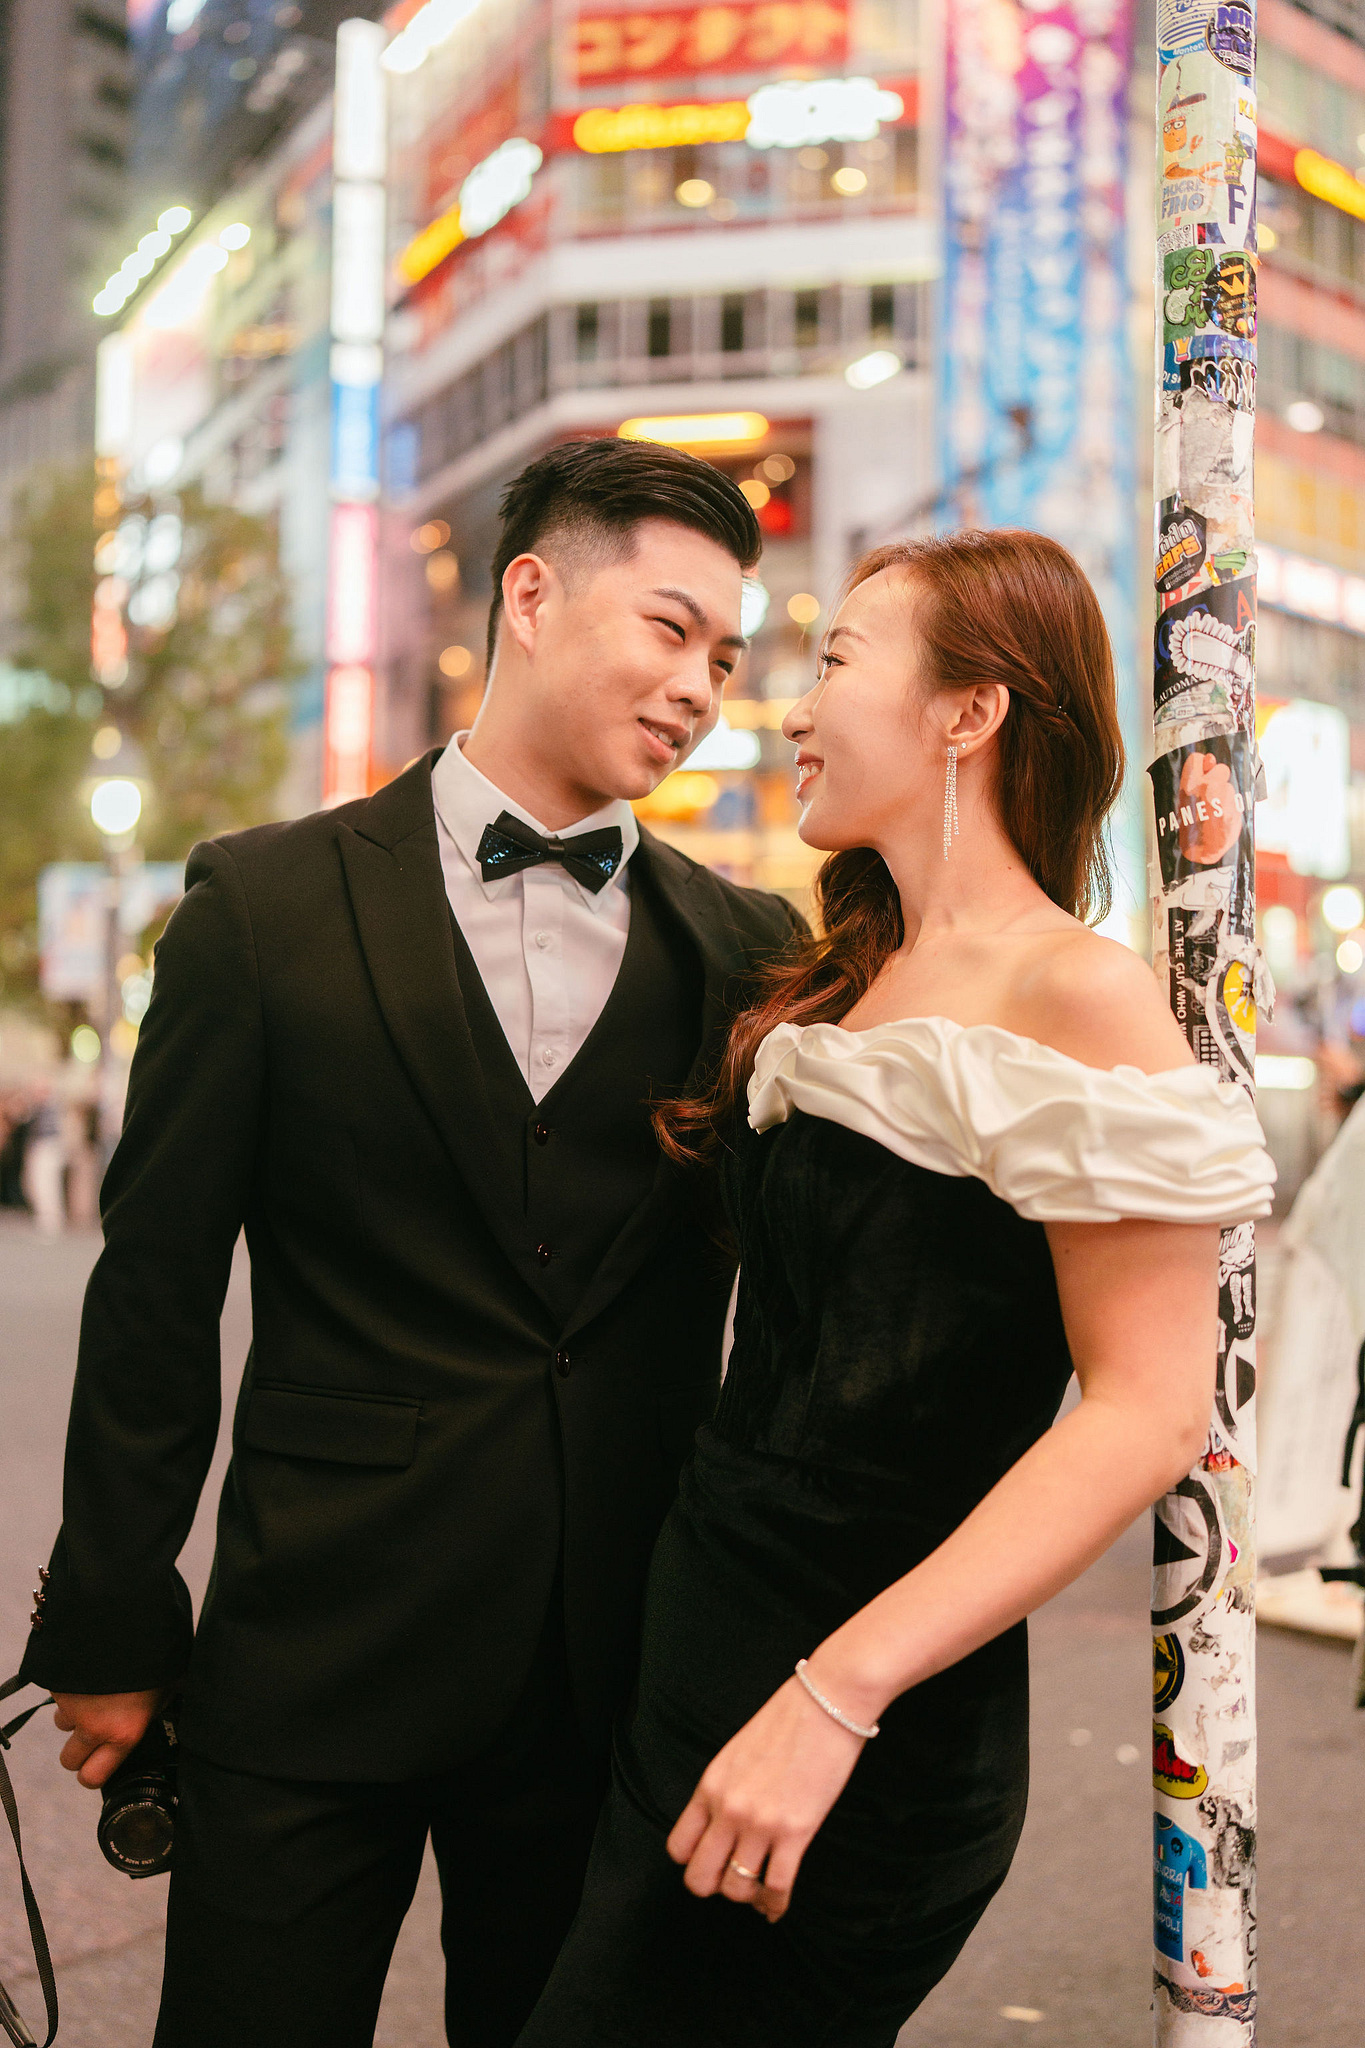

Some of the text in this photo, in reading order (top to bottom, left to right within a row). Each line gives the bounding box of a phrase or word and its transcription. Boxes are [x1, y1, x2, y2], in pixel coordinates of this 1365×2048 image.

[1159, 797, 1224, 836] PANES
[1174, 919, 1184, 933] AT
[1174, 936, 1185, 958] THE
[1176, 990, 1187, 1019] WHO
